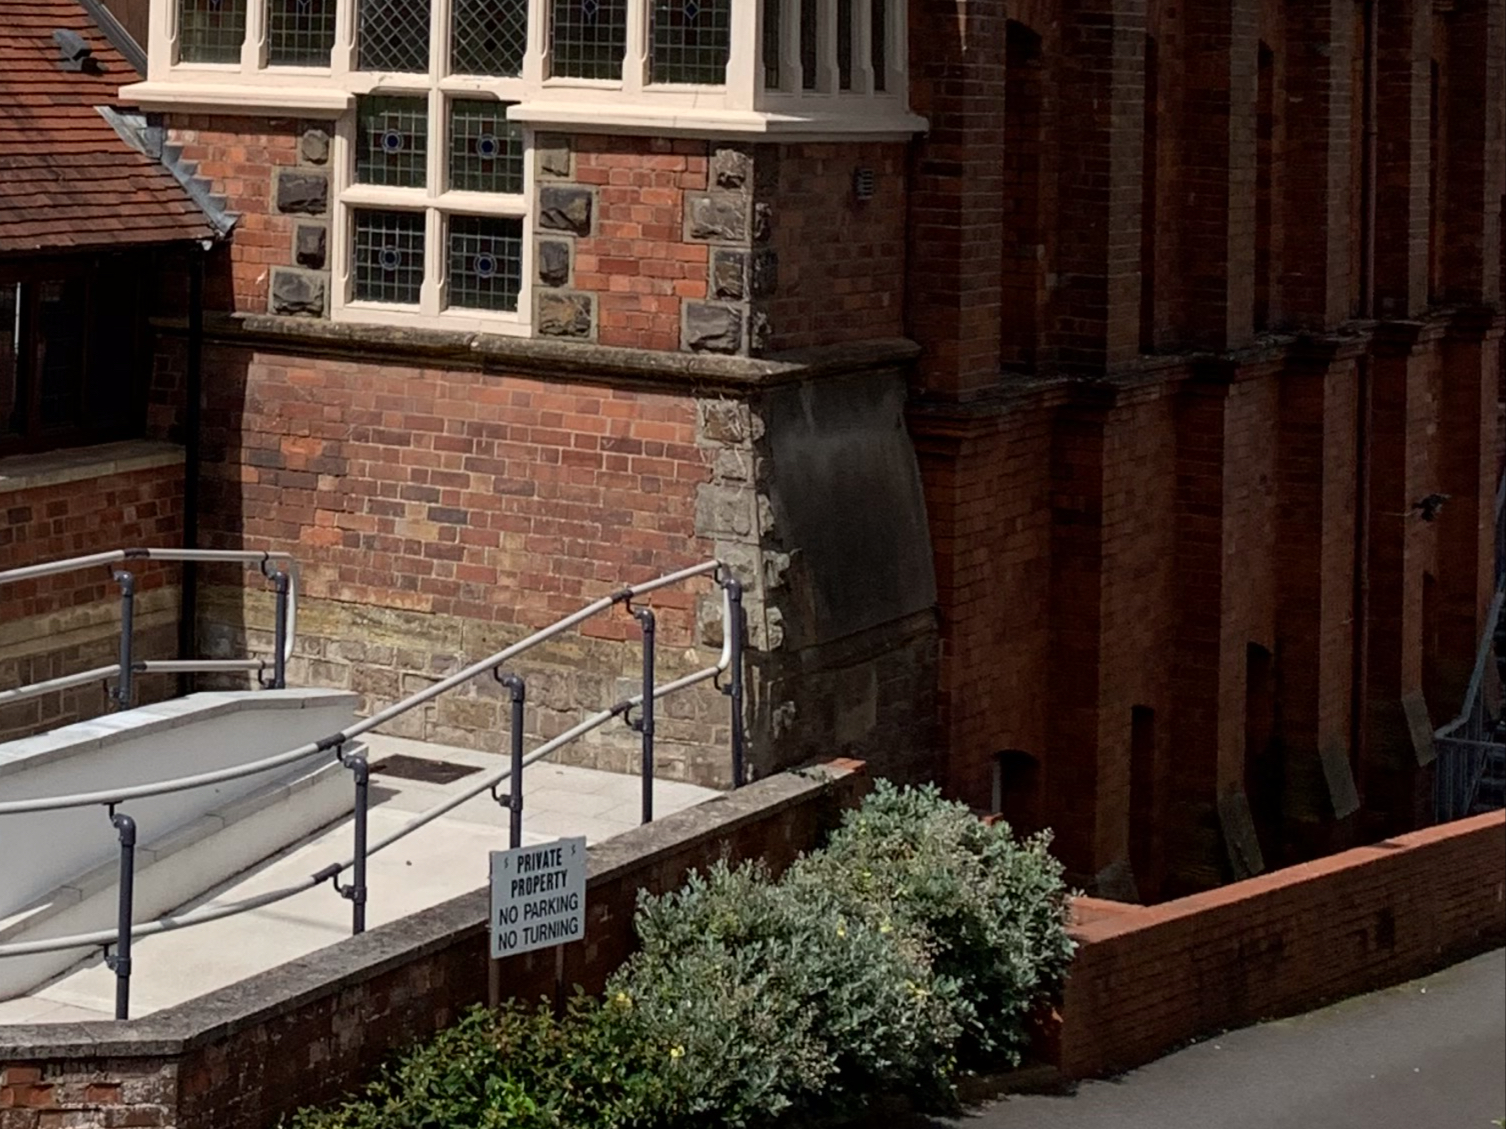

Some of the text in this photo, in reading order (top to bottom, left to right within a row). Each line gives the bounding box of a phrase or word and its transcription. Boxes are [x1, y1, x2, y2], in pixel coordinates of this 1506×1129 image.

[517, 847, 562, 874] PRIVATE
[511, 869, 568, 898] PROPERTY
[499, 892, 579, 926] NO PARKING
[498, 916, 579, 951] NO TURNING
